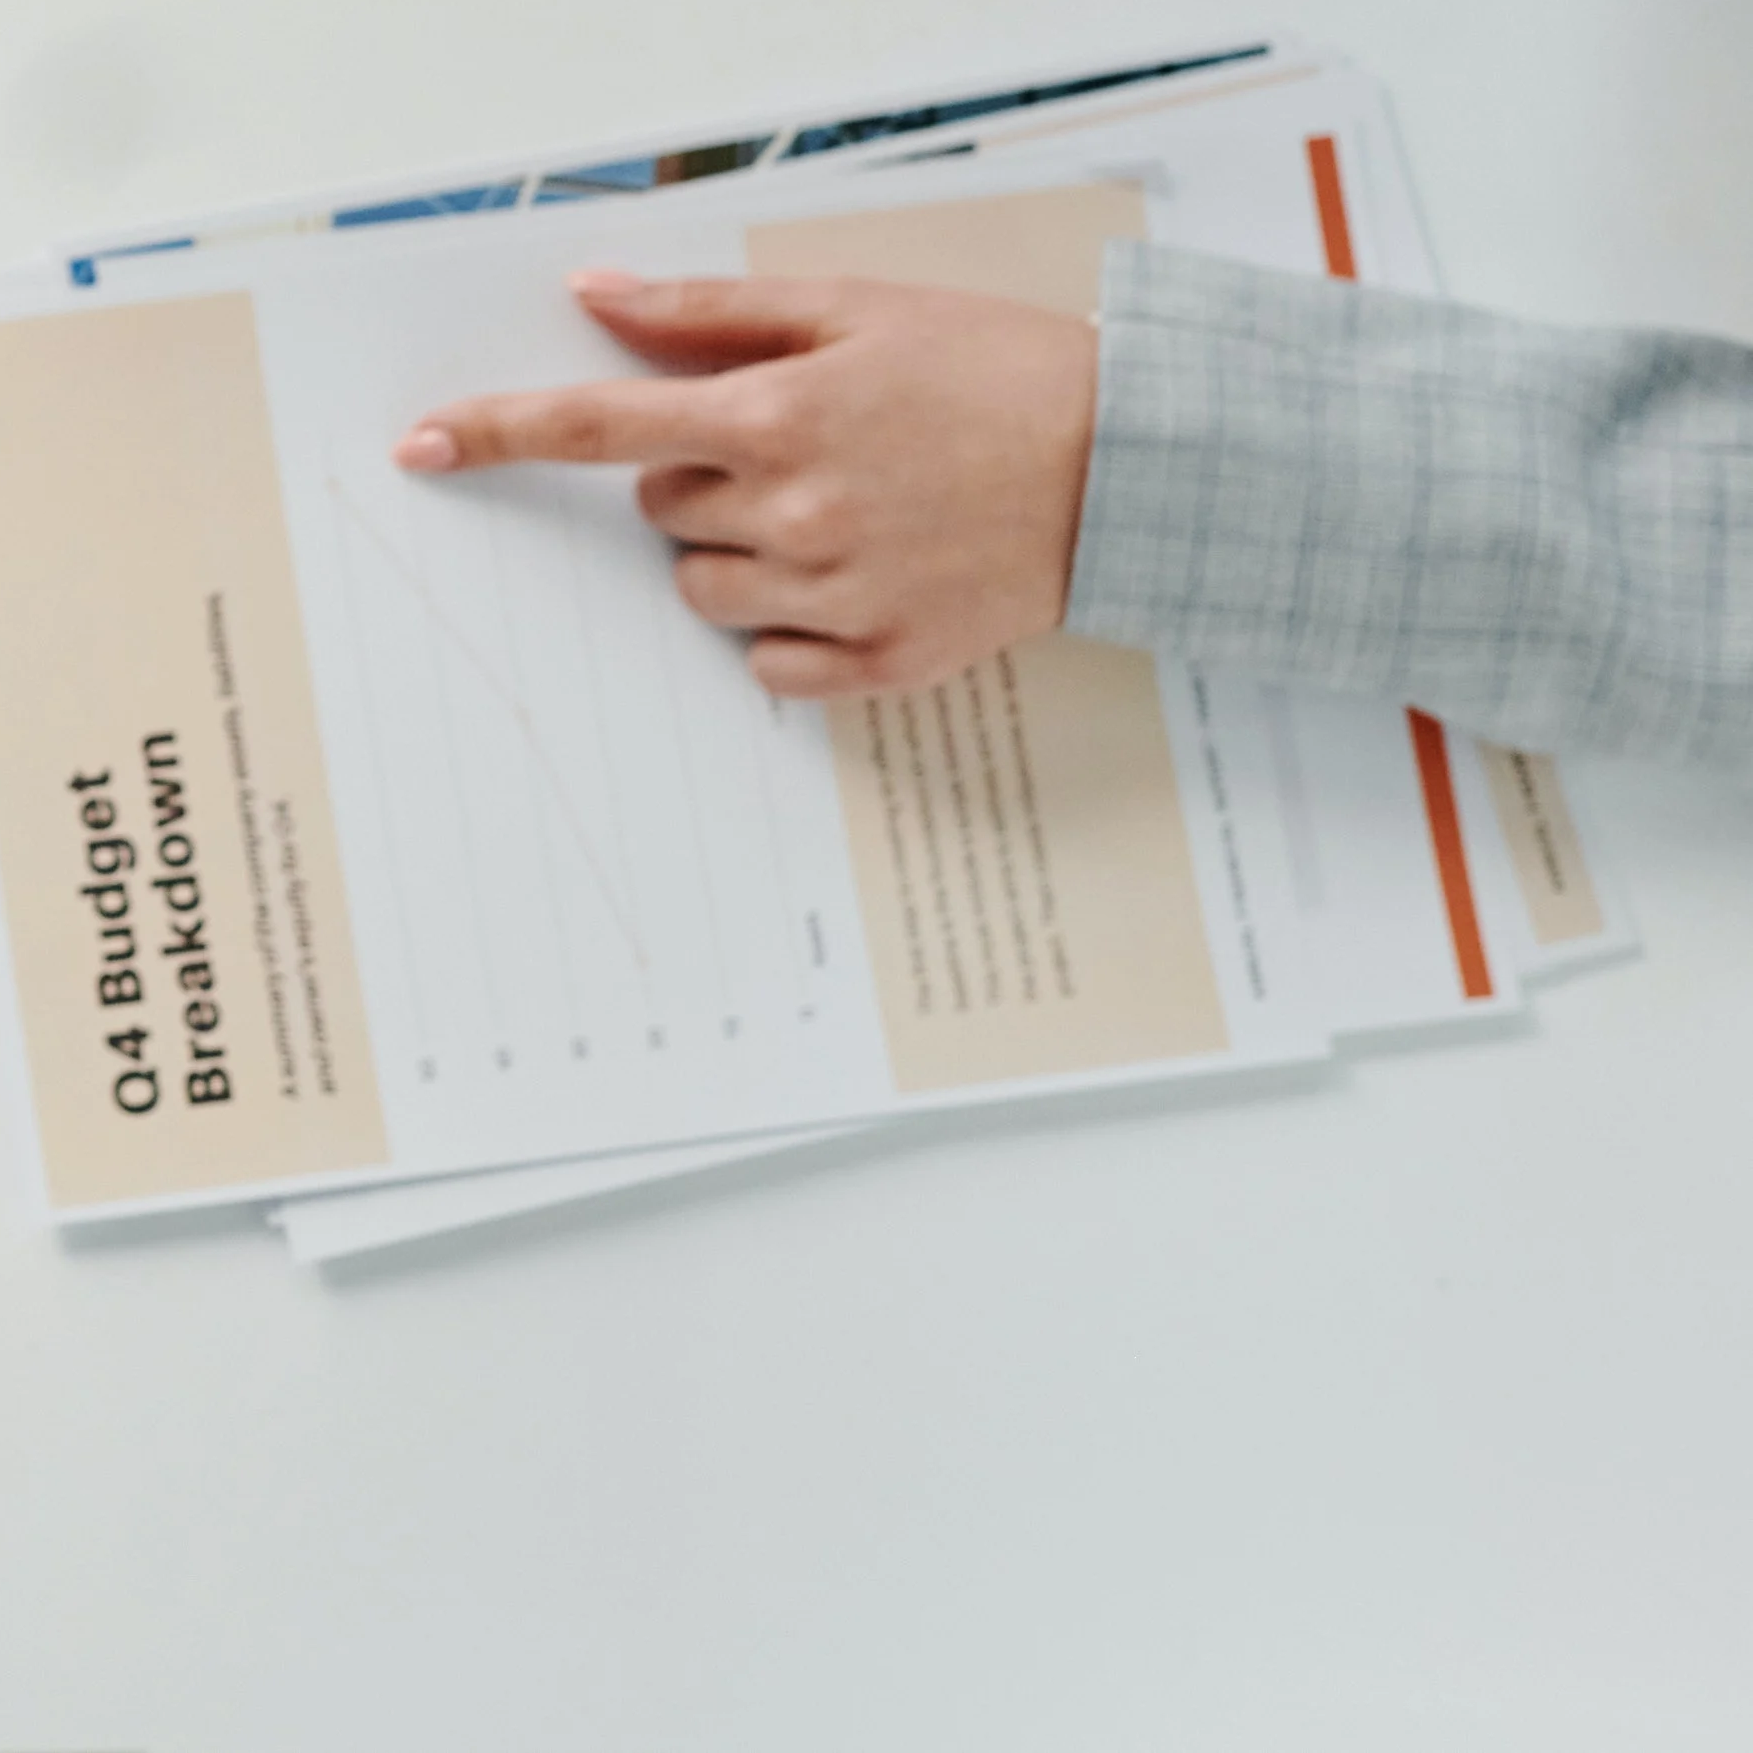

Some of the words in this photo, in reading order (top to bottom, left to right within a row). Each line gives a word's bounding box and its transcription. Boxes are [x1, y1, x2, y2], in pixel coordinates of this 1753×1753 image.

[69, 767, 144, 1009] Budget
[141, 730, 234, 1106] Breakdown
[106, 1027, 160, 1115] Q4
